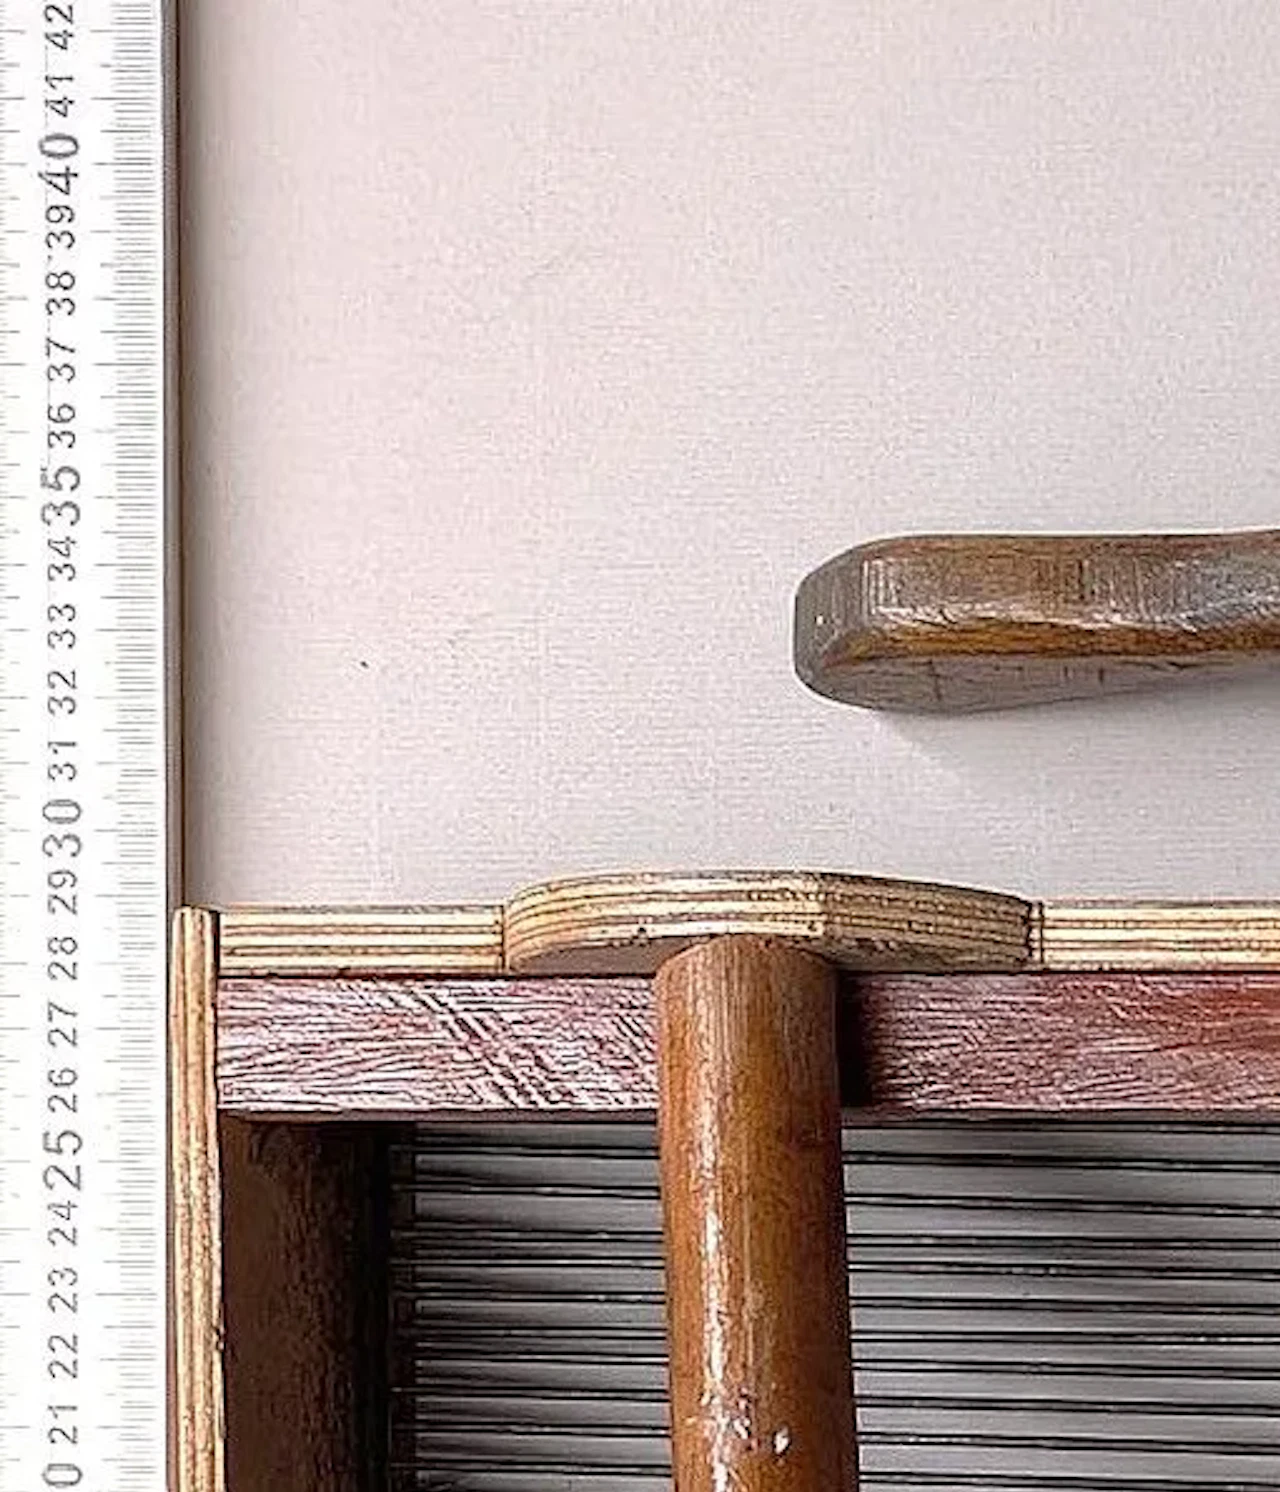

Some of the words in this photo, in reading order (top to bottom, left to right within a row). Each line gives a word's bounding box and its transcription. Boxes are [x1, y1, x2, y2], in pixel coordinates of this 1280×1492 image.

[43, 4, 74, 51] 42
[44, 75, 75, 118] 41
[37, 133, 80, 196] 40
[44, 204, 76, 250] 39
[45, 270, 76, 316] 38
[45, 337, 76, 383] 37
[47, 403, 76, 449] 36
[40, 466, 81, 527] 35
[47, 536, 77, 582] 34
[47, 603, 76, 649] 33
[47, 670, 77, 715] 32
[47, 741, 77, 781] 31
[42, 799, 82, 858] 30
[47, 870, 78, 915] 29
[47, 936, 78, 980] 28
[47, 1002, 77, 1047] 27
[47, 1068, 78, 1113] 26
[42, 1130, 83, 1191] 25
[47, 1200, 78, 1246] 24
[47, 1267, 78, 1313] 23
[47, 1334, 78, 1379] 22
[47, 1405, 78, 1444] 21
